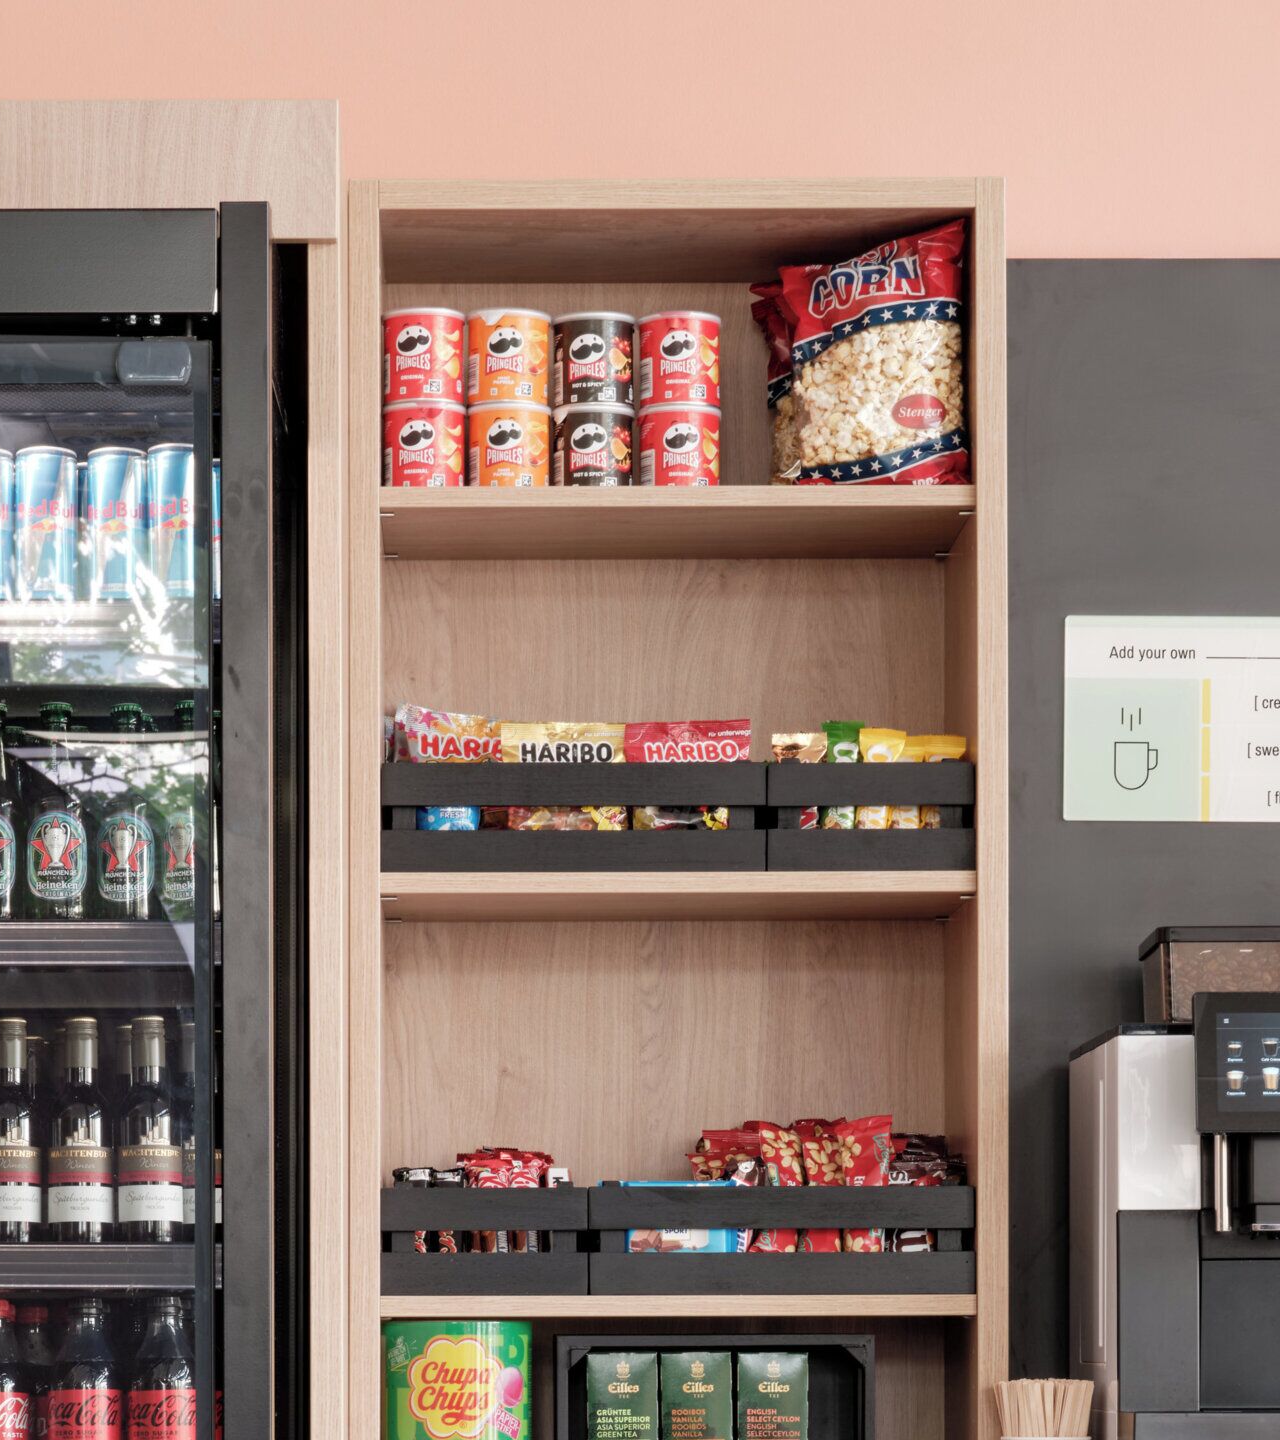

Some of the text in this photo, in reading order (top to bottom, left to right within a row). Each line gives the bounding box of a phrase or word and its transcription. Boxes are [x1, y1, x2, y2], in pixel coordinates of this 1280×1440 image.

[809, 256, 925, 319] CORN
[396, 354, 430, 372] PRINGLES
[487, 356, 523, 373] PRINGLES
[570, 362, 606, 379] PRINGLES
[660, 359, 696, 376] PRINGLES
[898, 405, 942, 419] Stenger
[399, 450, 434, 466] PRINGLES
[486, 450, 523, 466] PRINGLES
[571, 452, 607, 469] PRINGLES
[663, 452, 699, 468] PRINGLES
[1109, 646, 1196, 661] Add your own
[521, 742, 613, 762] HARIBO
[644, 740, 739, 761] HARIBO
[35, 881, 78, 890] Heineken
[421, 1362, 491, 1391] Chupa
[418, 1386, 489, 1412] Chups
[597, 1408, 631, 1416] GRÜNTEE
